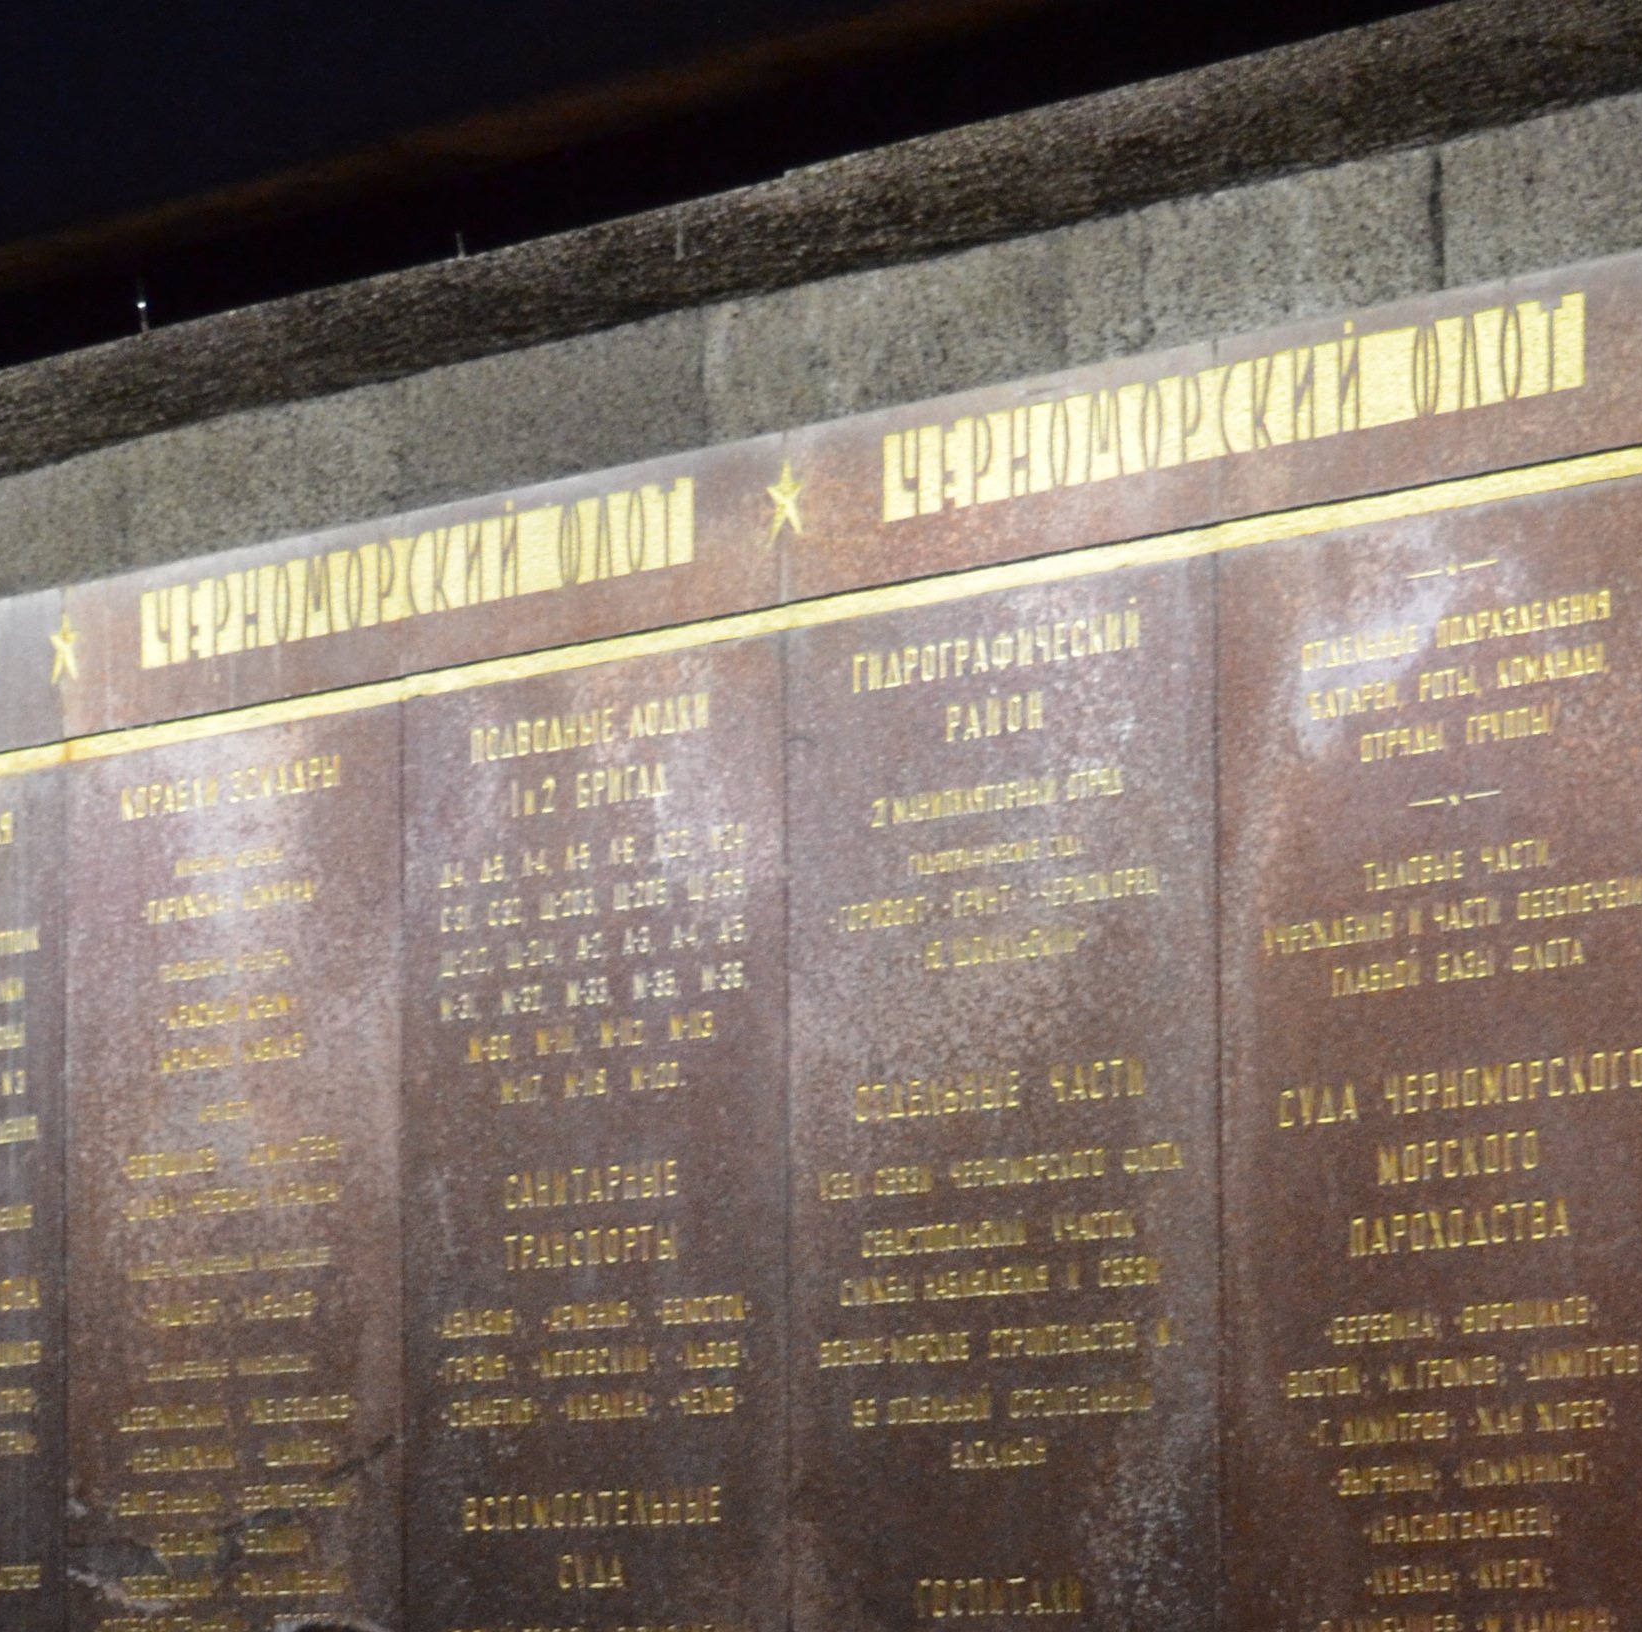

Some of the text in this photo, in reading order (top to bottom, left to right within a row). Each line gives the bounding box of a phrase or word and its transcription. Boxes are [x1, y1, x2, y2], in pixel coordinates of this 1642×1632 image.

[1407, 290, 1589, 422] ФЛОТ
[852, 596, 1141, 693] ГИДРОГРАФИЧЕСКИЙ
[1279, 1082, 1358, 1129] СУДА
[1378, 1128, 1540, 1186] МОРСКОГО
[1349, 1198, 1572, 1258] ПАРОХОДСТВА
